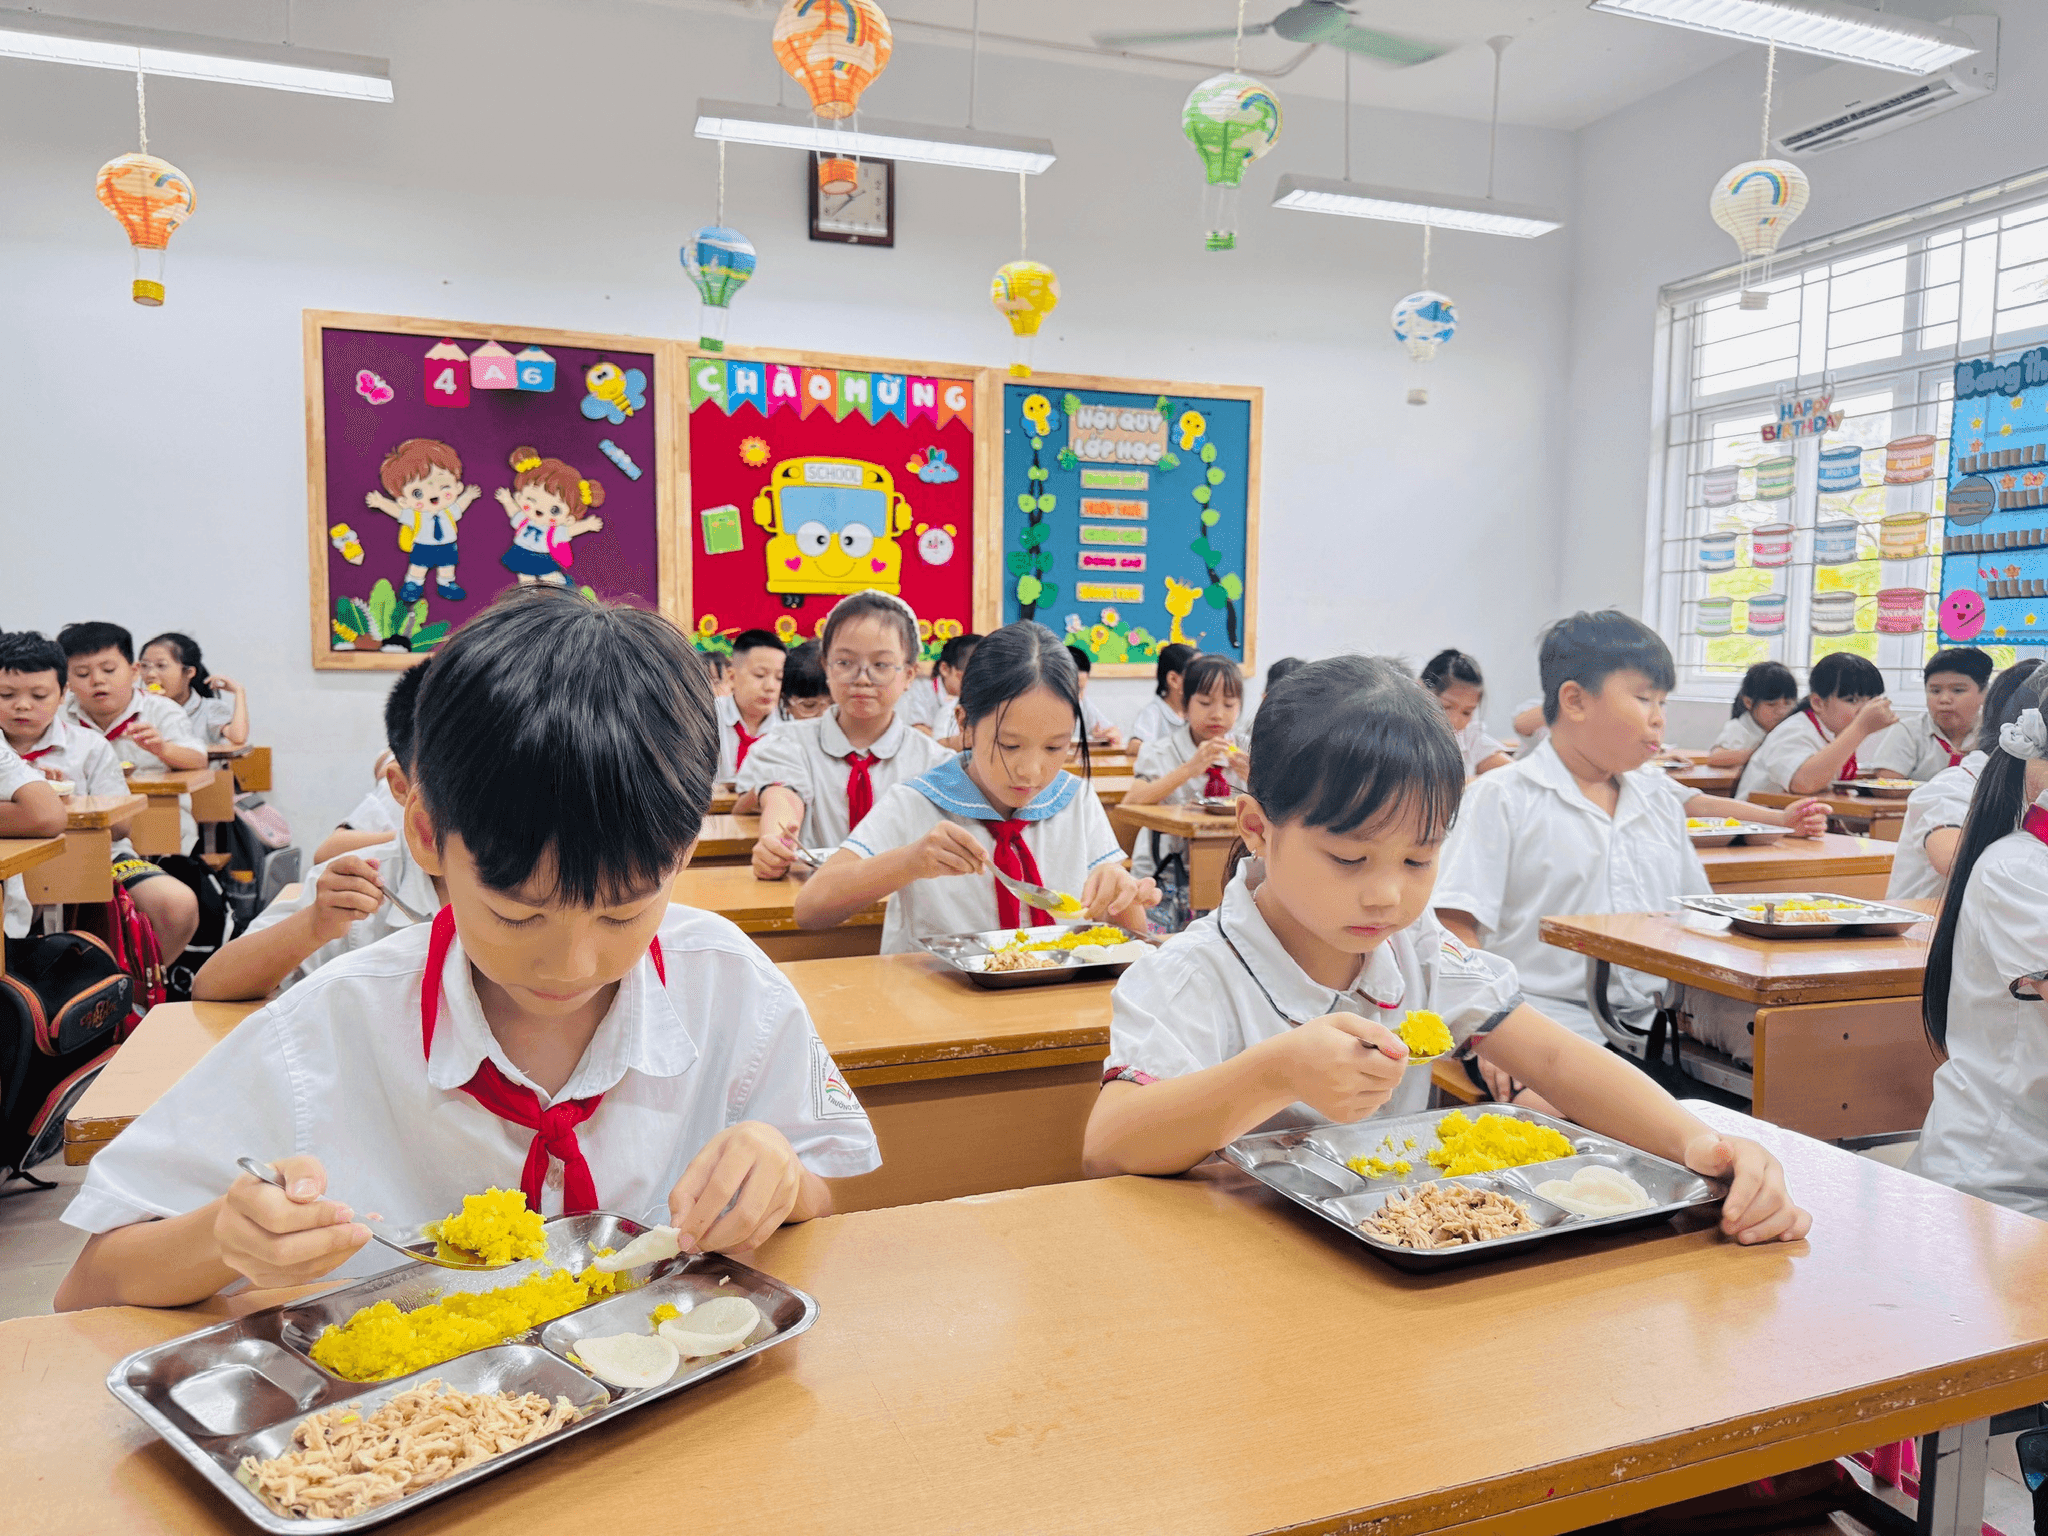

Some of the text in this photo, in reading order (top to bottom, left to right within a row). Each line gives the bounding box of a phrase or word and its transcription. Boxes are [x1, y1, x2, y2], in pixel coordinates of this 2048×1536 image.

[697, 365, 966, 411] CHÀO MỪNG
[1077, 404, 1163, 434] NỘI QUY
[1780, 395, 1831, 421] HAPPY
[1762, 412, 1844, 441] BIRTHDAY
[1074, 432, 1161, 464] LỚP HỌC
[807, 464, 859, 483] SCHOOL
